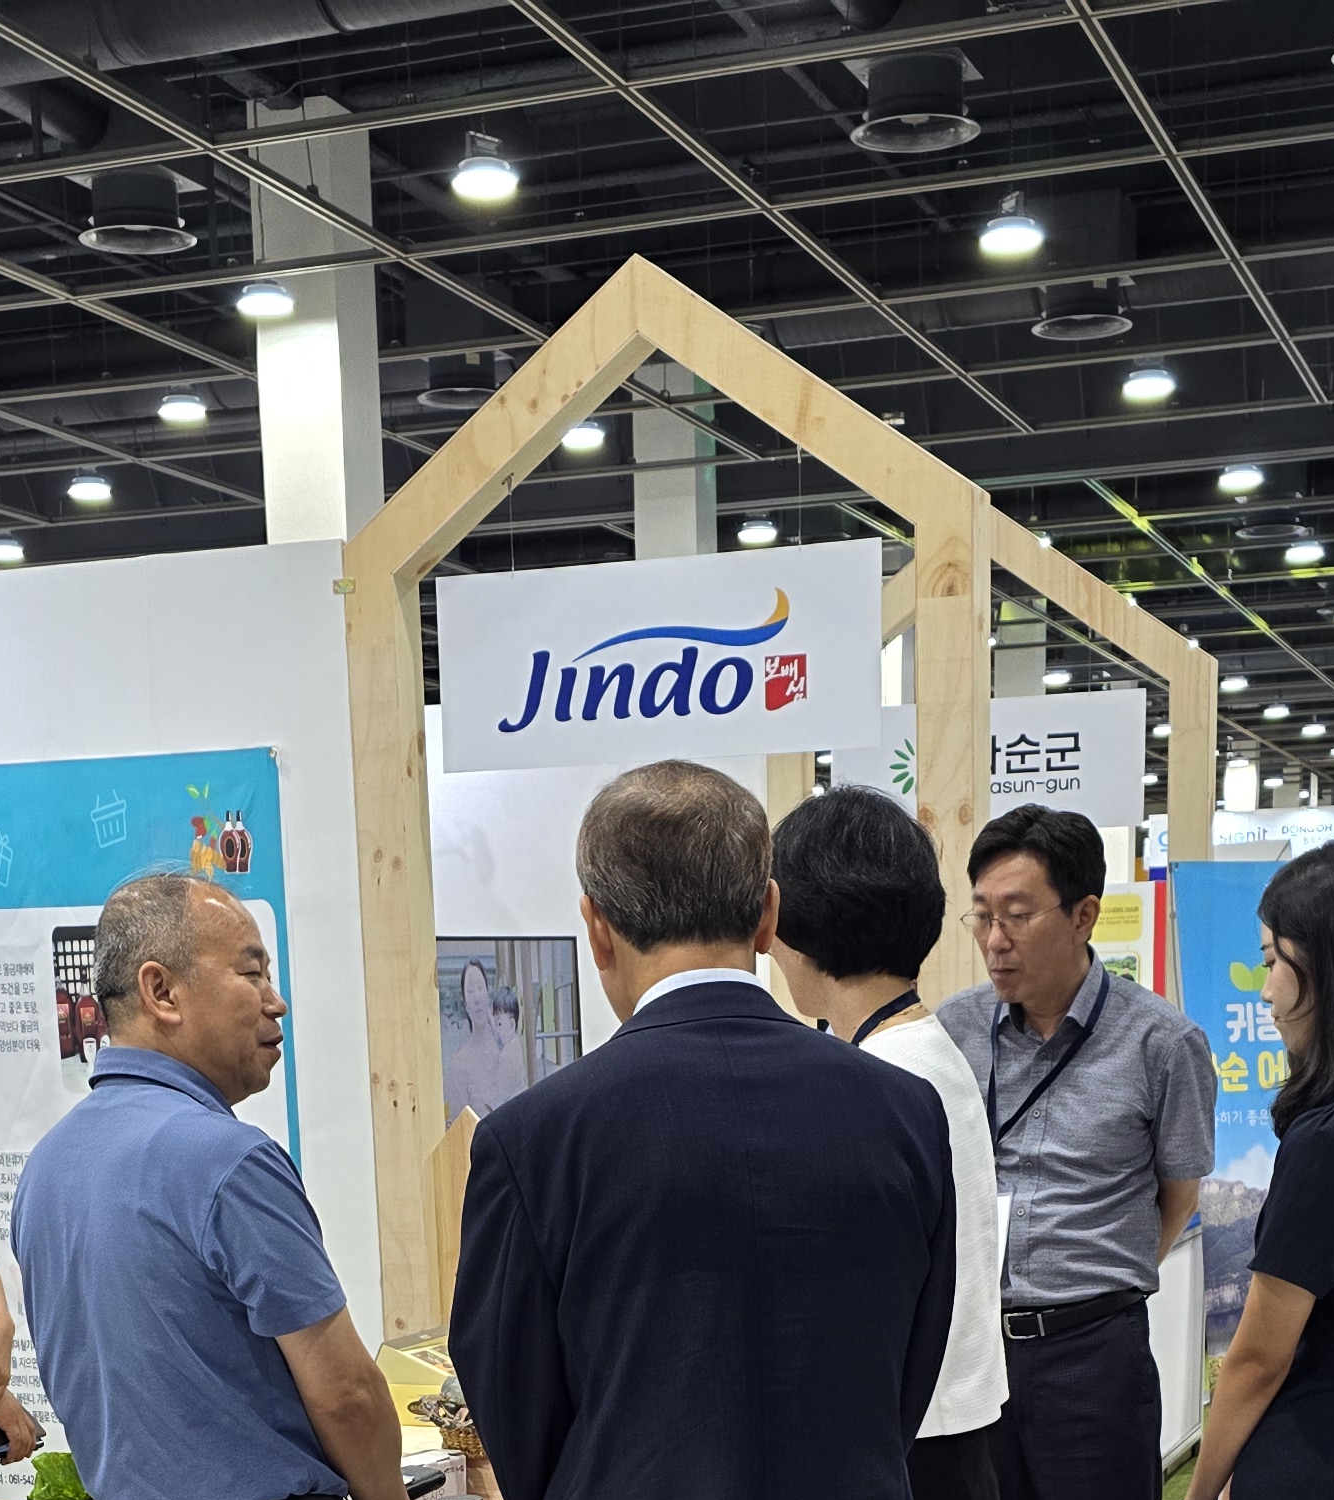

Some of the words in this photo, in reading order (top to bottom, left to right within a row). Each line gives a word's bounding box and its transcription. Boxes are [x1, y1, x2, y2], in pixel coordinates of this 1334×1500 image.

[765, 656, 806, 702] 보배섬
[497, 646, 752, 734] Jindo
[990, 776, 1081, 794] asun-gun
[22, 982, 36, 994] 모두
[8, 1001, 22, 1014] 좋은
[20, 1019, 40, 1034] 울금의
[27, 1039, 41, 1052] 더욱
[1247, 1109, 1269, 1127] 좋은
